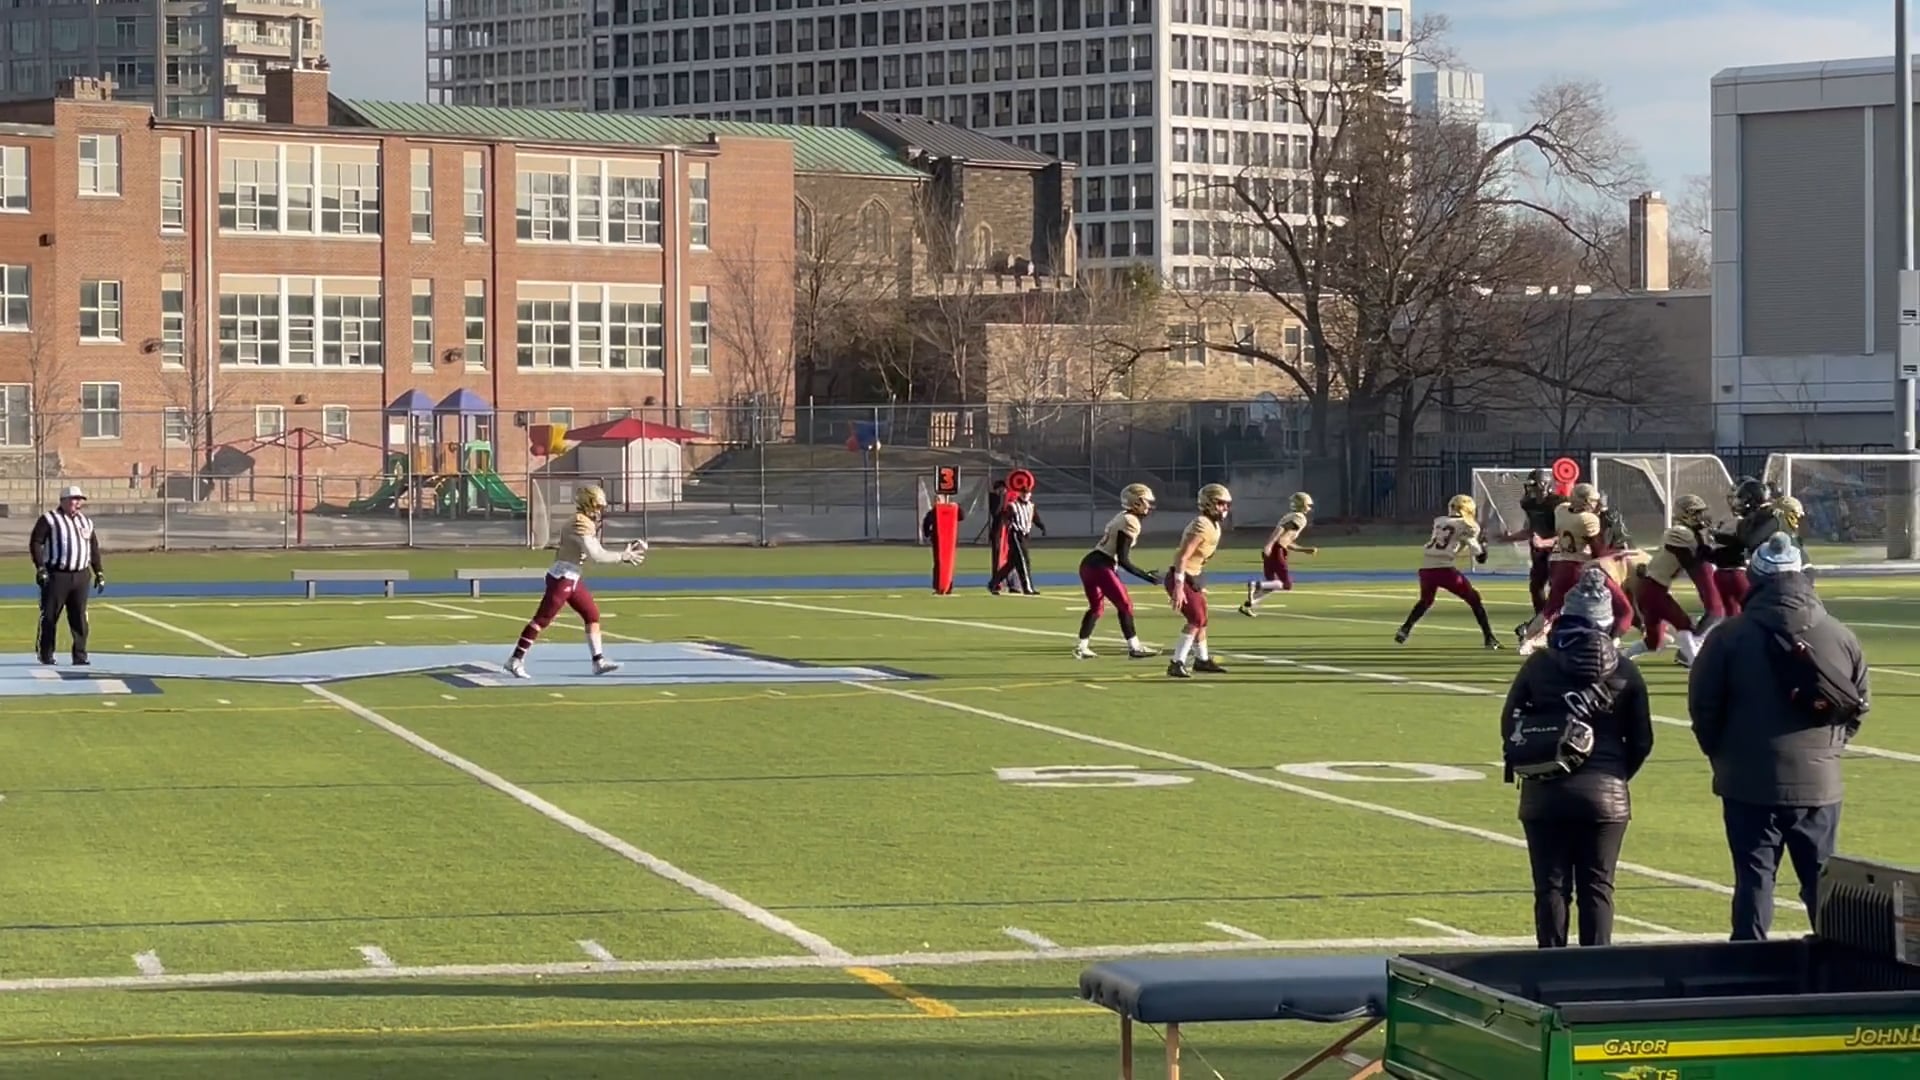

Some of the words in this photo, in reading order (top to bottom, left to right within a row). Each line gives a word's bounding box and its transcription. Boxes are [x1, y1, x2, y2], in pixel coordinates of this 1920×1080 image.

[940, 468, 954, 490] 3
[1845, 1026, 1909, 1046] JOHN
[1604, 1039, 1668, 1056] GATOR
